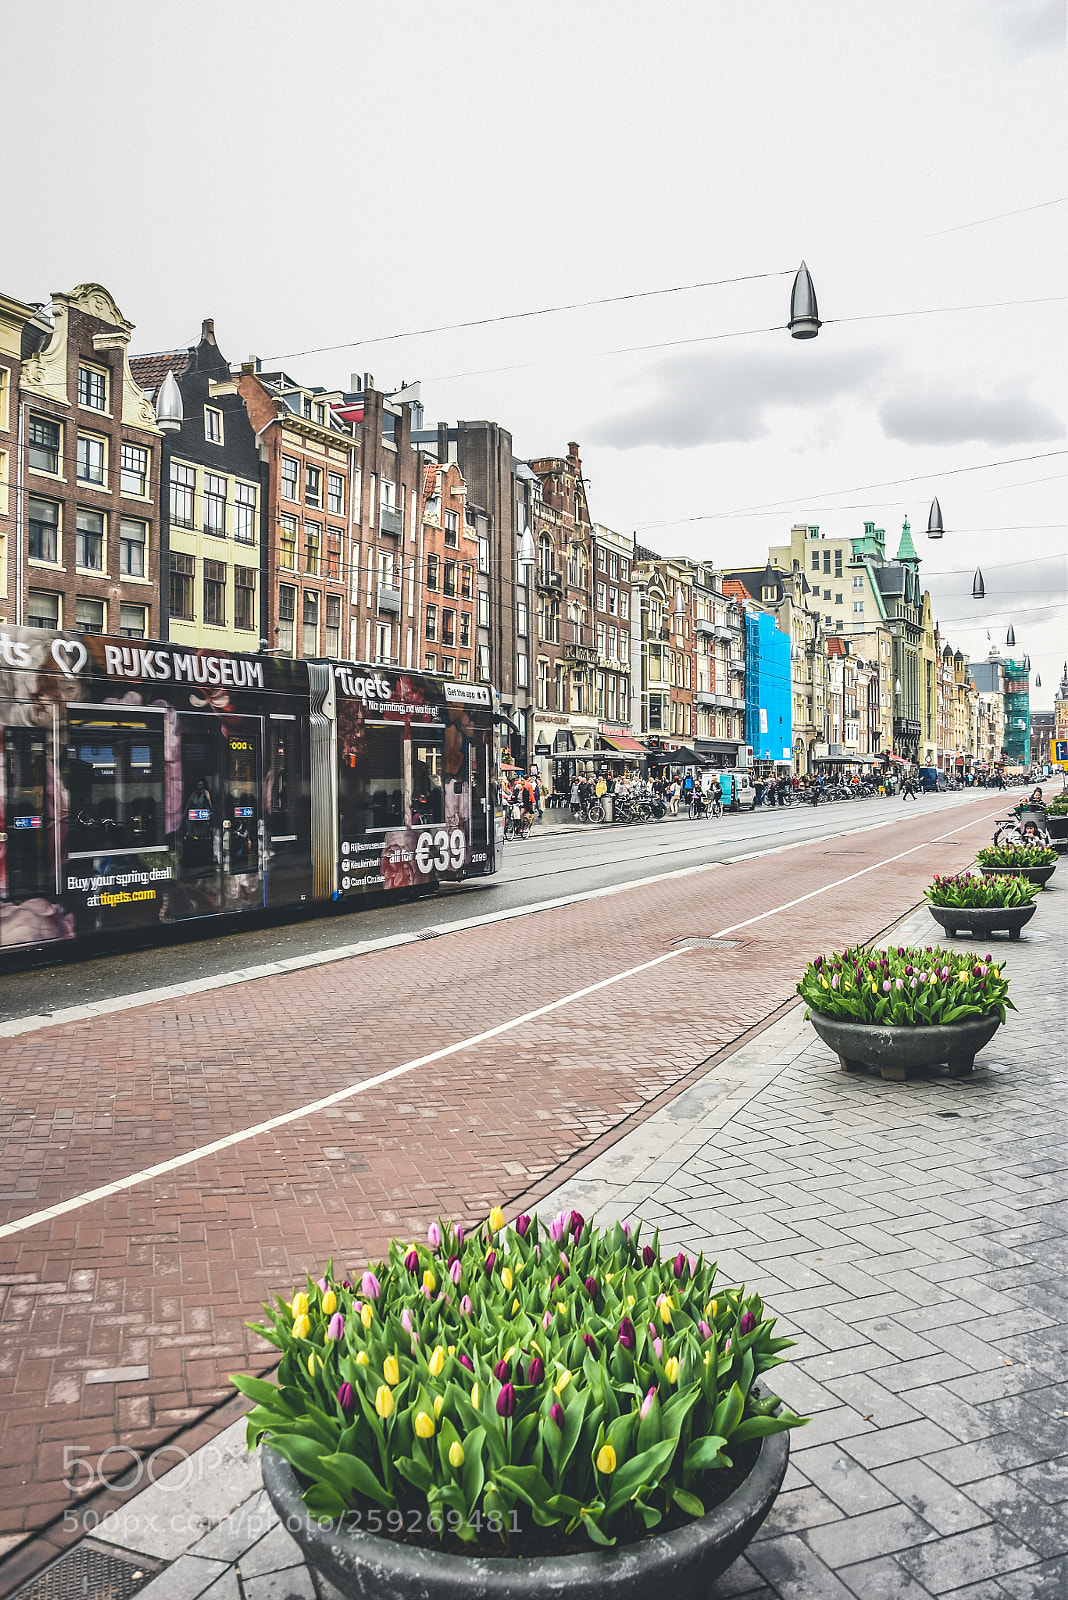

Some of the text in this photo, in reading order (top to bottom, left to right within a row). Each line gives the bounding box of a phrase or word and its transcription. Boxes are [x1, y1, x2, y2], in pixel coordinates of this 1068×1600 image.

[172, 652, 265, 688] MUSEUM
[334, 667, 392, 706] Tiqets
[447, 687, 475, 699] Get the app
[368, 700, 379, 710] No
[415, 829, 466, 874] €39
[67, 866, 172, 891] Buy your spring deal
